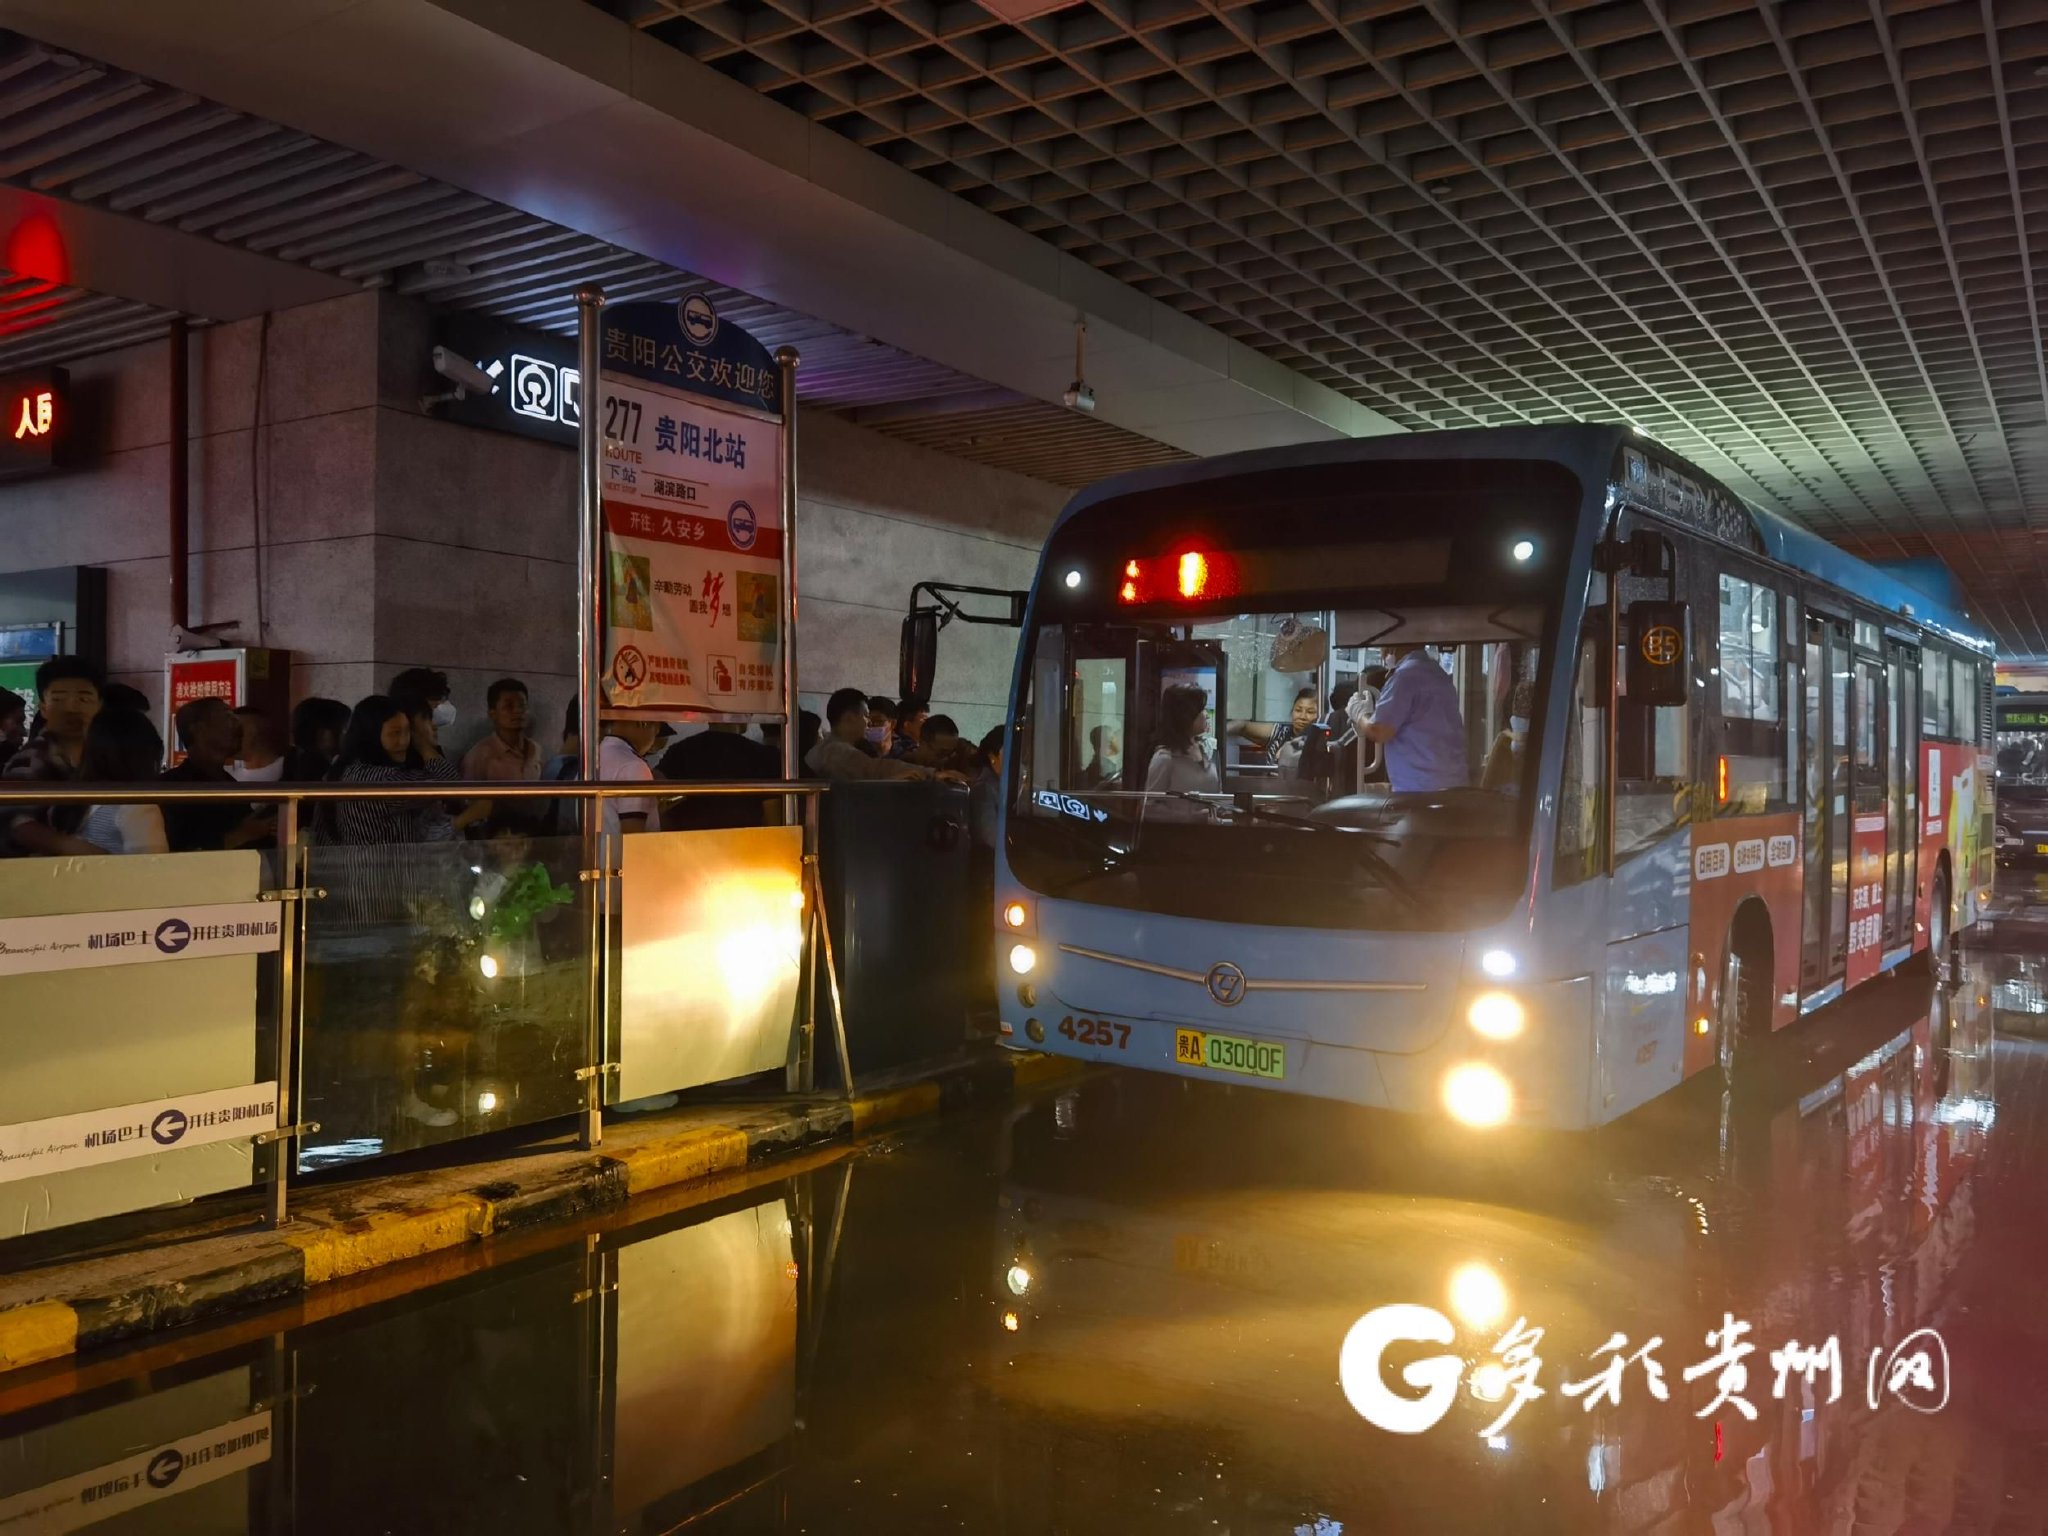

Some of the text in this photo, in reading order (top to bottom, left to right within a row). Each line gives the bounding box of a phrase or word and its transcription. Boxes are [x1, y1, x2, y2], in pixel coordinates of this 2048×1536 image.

[604, 327, 775, 401] 贵阳公交欢迎您
[604, 395, 643, 444] 277
[605, 445, 643, 465] ROUTE
[655, 415, 747, 470] 贵阳北站
[605, 463, 637, 484] 下站
[653, 479, 696, 501] 湖滨路口
[87, 930, 152, 950] 机场巴士
[192, 921, 278, 942] 开往贵阳机场
[1058, 1016, 1132, 1050] 4257
[189, 1101, 274, 1129] 开往贵阳机场
[84, 1123, 149, 1150] 机场巴士
